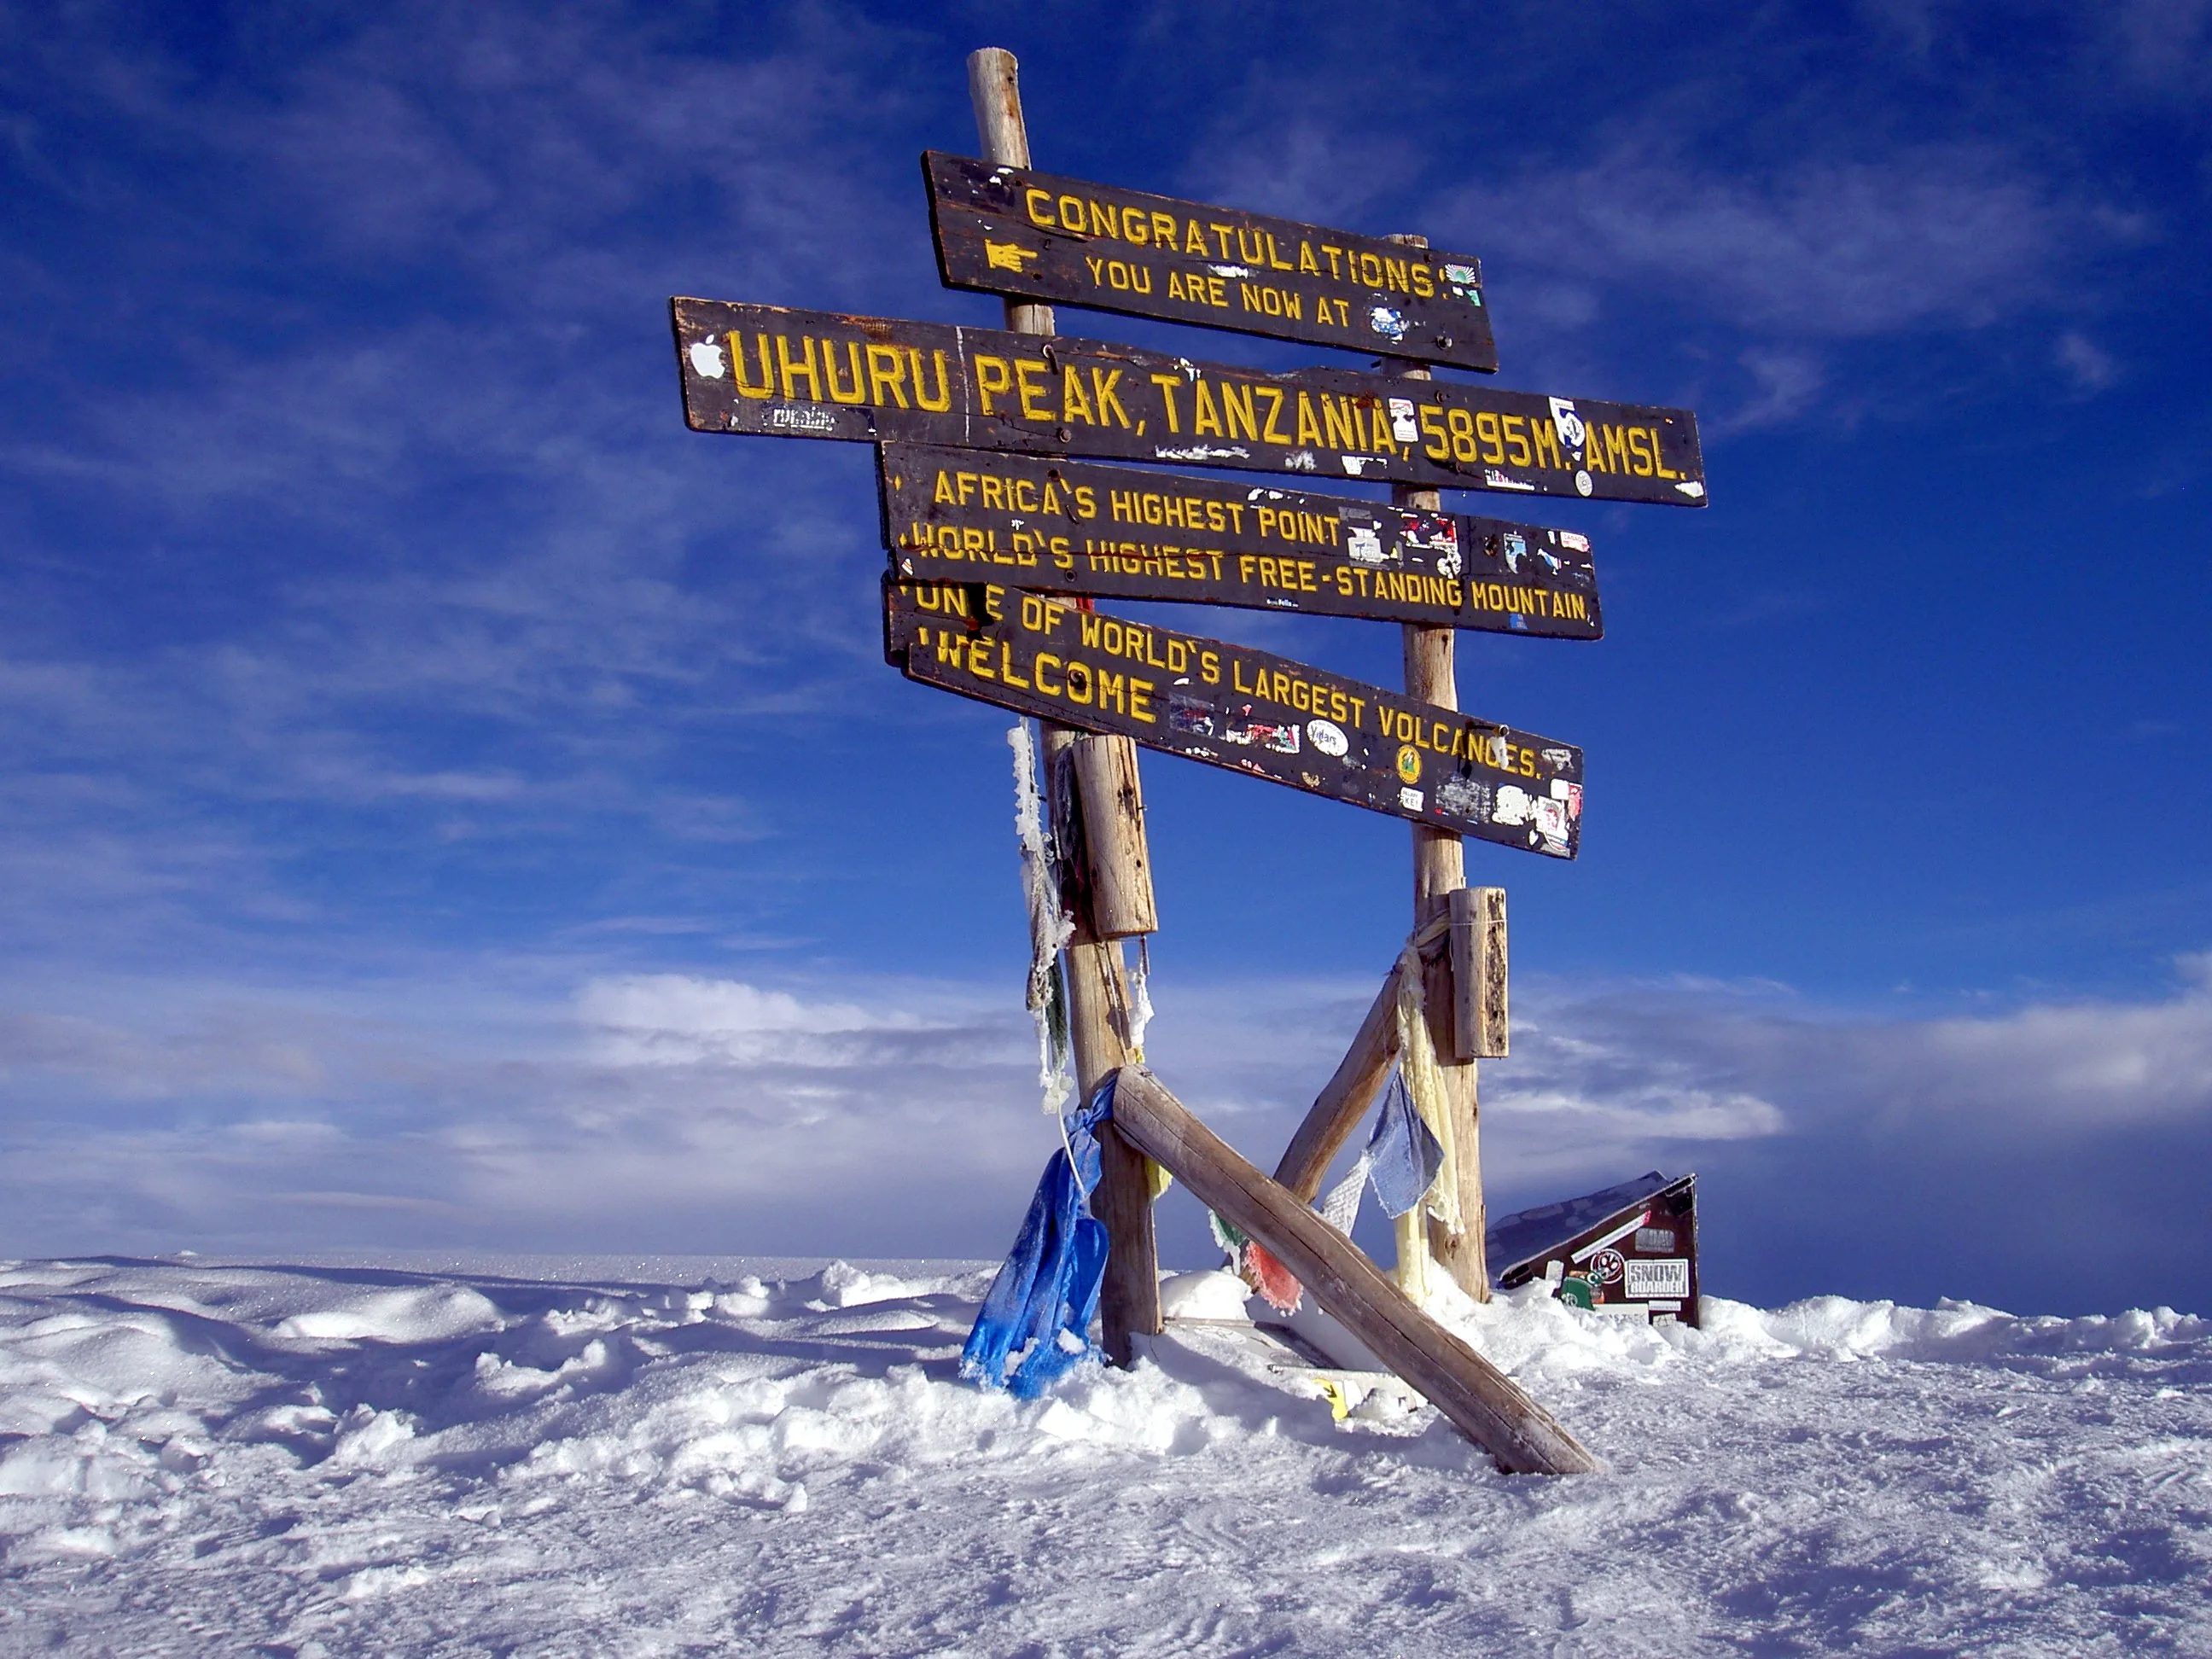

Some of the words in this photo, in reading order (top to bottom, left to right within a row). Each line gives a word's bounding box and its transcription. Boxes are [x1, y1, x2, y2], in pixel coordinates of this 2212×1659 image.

[1085, 256, 1151, 294] YOU
[1168, 271, 1229, 307] ARE
[1240, 282, 1302, 320] NOW
[1317, 296, 1349, 328] AT
[728, 329, 952, 413] UHURU
[974, 353, 1146, 436] PEAK,
[1150, 373, 1410, 462] TANZANIA,
[1418, 404, 1572, 471] 5895M.
[1586, 422, 1686, 480] AMSL.
[934, 469, 1097, 519] AFRICA'S
[1110, 489, 1244, 533] HIGHEST
[1258, 507, 1340, 546] POINT
[911, 521, 1074, 569] WORLD'S
[1086, 538, 1224, 581] HIGHEST
[1239, 554, 1463, 607] FREE-STANDING
[1470, 581, 1586, 620] MOUNTAIN
[916, 584, 1005, 621] ONE
[1022, 596, 1066, 636] OF
[1081, 612, 1220, 684] WORLD'S
[1233, 660, 1365, 728] LARGEST
[937, 630, 1155, 724] WELCOME
[1630, 1265, 1683, 1281] SNOW
[1630, 1281, 1683, 1293] BOARDER
